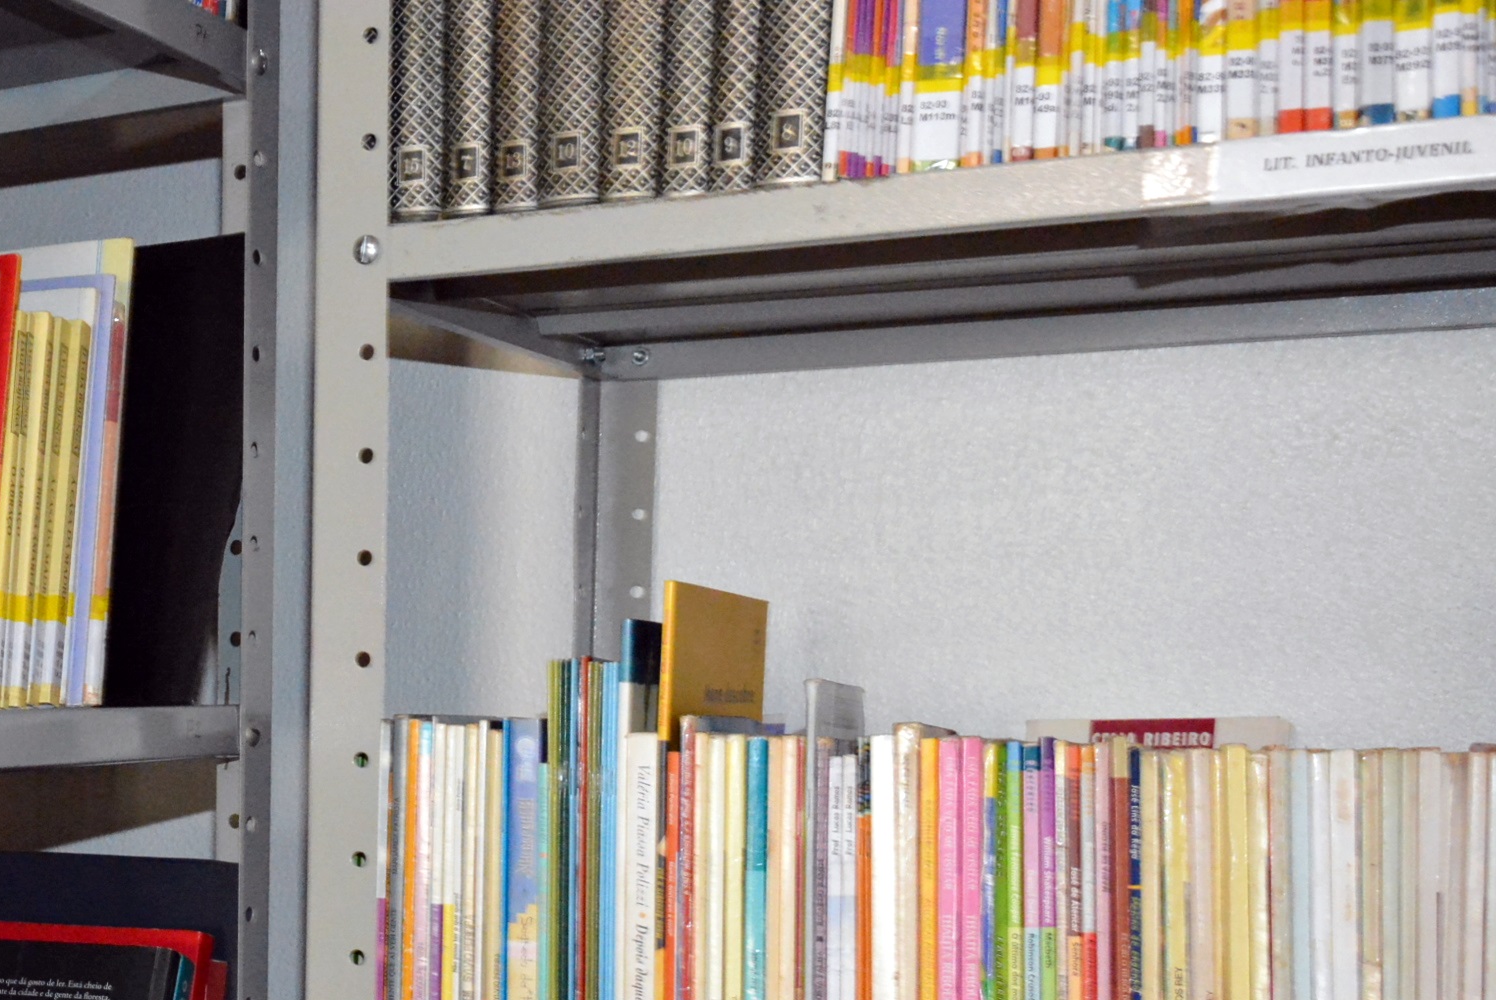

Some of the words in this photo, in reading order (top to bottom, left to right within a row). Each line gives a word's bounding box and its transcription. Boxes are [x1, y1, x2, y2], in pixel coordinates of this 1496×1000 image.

[619, 140, 637, 157] 12
[676, 139, 692, 156] 10
[1264, 156, 1296, 171] LIT.
[1305, 141, 1473, 168] INFANTO-JUVENIL
[1142, 731, 1212, 749] RIBEIRO
[636, 764, 651, 810] Valéria
[635, 862, 651, 913] Polizzi
[635, 922, 650, 969] Depois
[6, 977, 17, 986] que
[27, 979, 45, 988] gosto
[68, 980, 82, 989] Está
[83, 981, 102, 990] cheio
